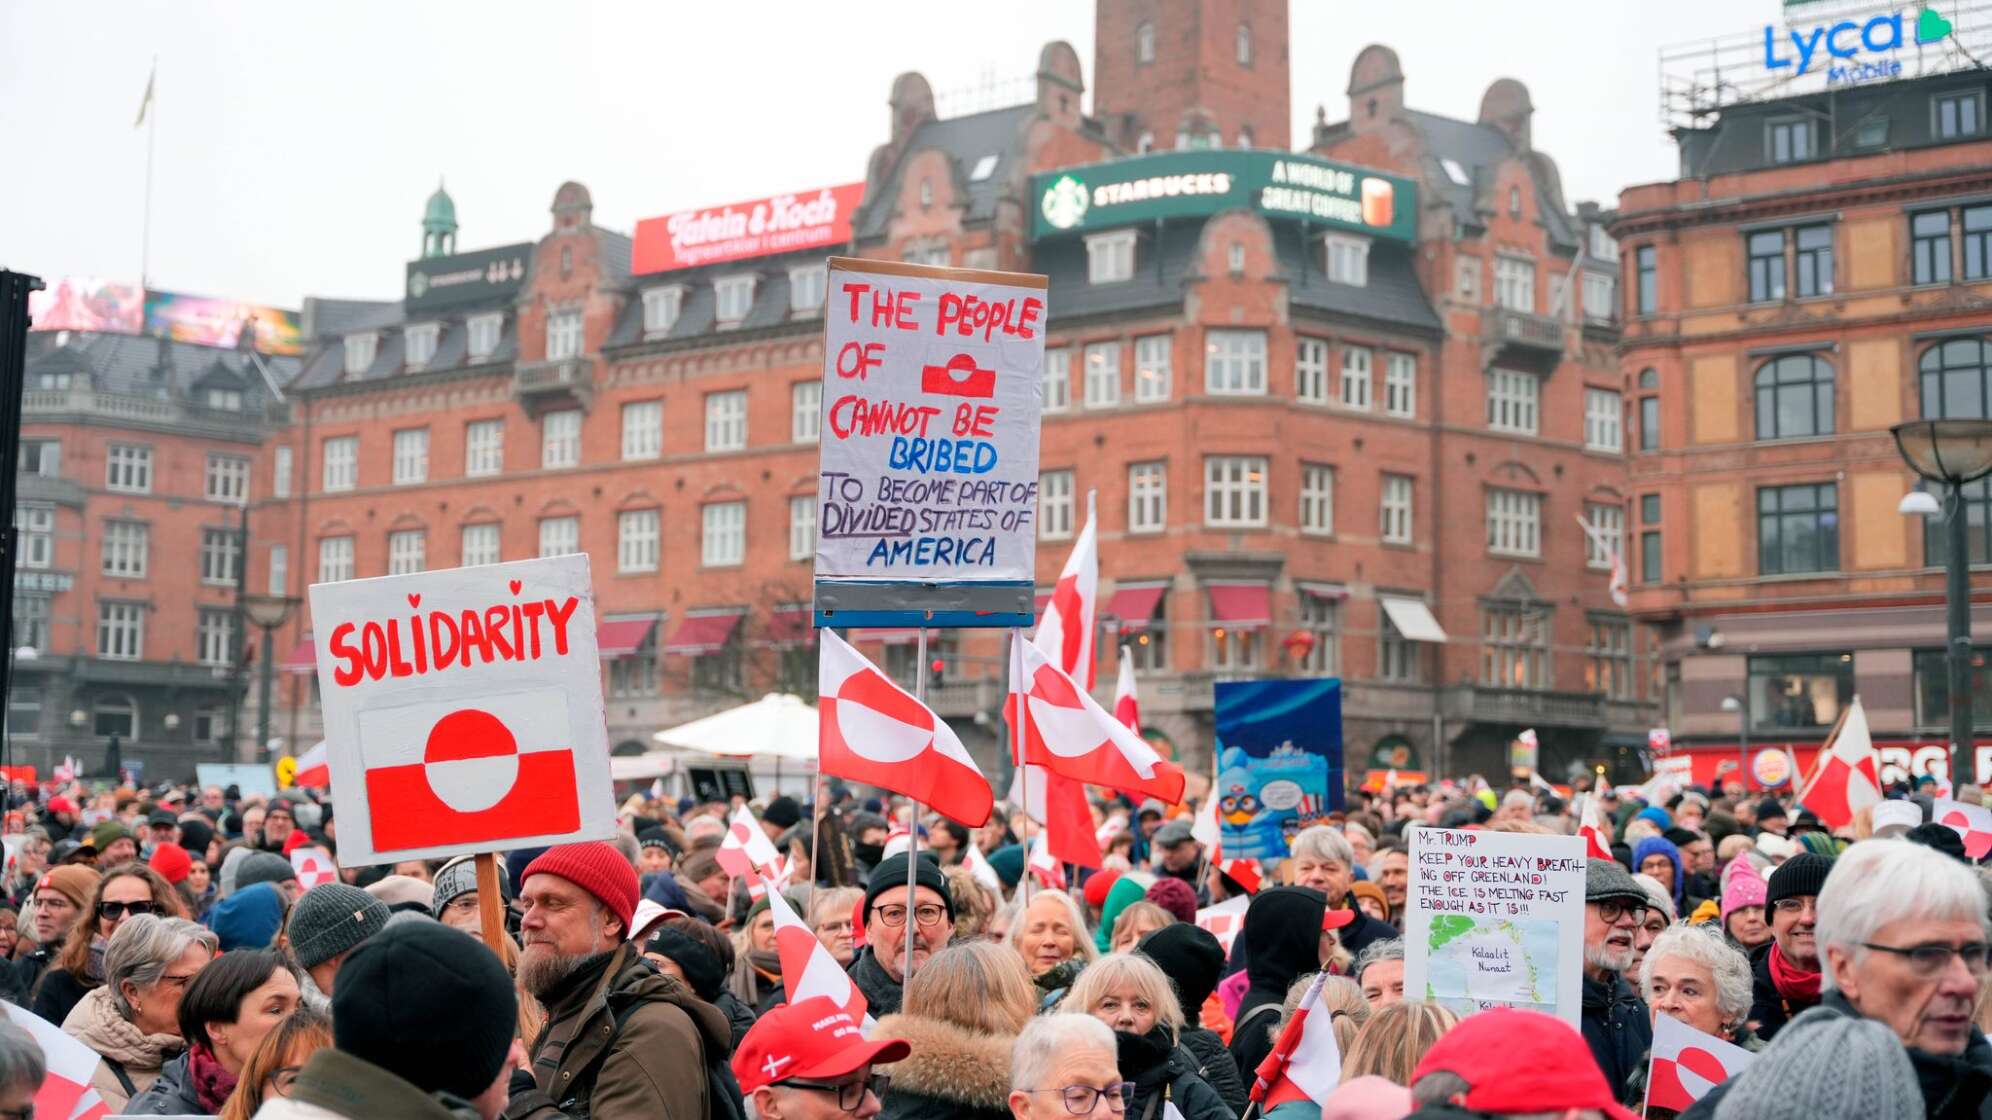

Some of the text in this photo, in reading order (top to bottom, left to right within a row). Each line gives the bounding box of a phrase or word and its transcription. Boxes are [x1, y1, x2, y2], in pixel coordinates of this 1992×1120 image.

[1764, 12, 1903, 77] Lyca
[1827, 59, 1902, 83] Mobile
[1094, 173, 1230, 206] STARBUCKS
[842, 284, 1043, 342] THE PEOPLE
[836, 342, 886, 381] OF
[829, 395, 1000, 439] CANNOT BE
[889, 436, 998, 474] BRIBED
[821, 472, 1037, 507] TO BECOME PART OF
[919, 508, 996, 534] STATES
[1001, 510, 1032, 534] OF
[867, 536, 995, 568] AMERICA
[329, 580, 580, 687] SOLIDARITY
[1437, 831, 1477, 847] TRUMP
[1418, 851, 1453, 866] KEEP
[1458, 854, 1488, 869] YOUR
[1492, 856, 1533, 870] HEAVY
[1443, 871, 1465, 882] OFF
[1471, 870, 1547, 885] GREENLAND!
[1418, 885, 1444, 896] THE
[1489, 888, 1535, 901] MELTING
[1539, 890, 1568, 903] FAST
[1420, 898, 1464, 912] ENOUGH
[1469, 900, 1485, 913] AS
